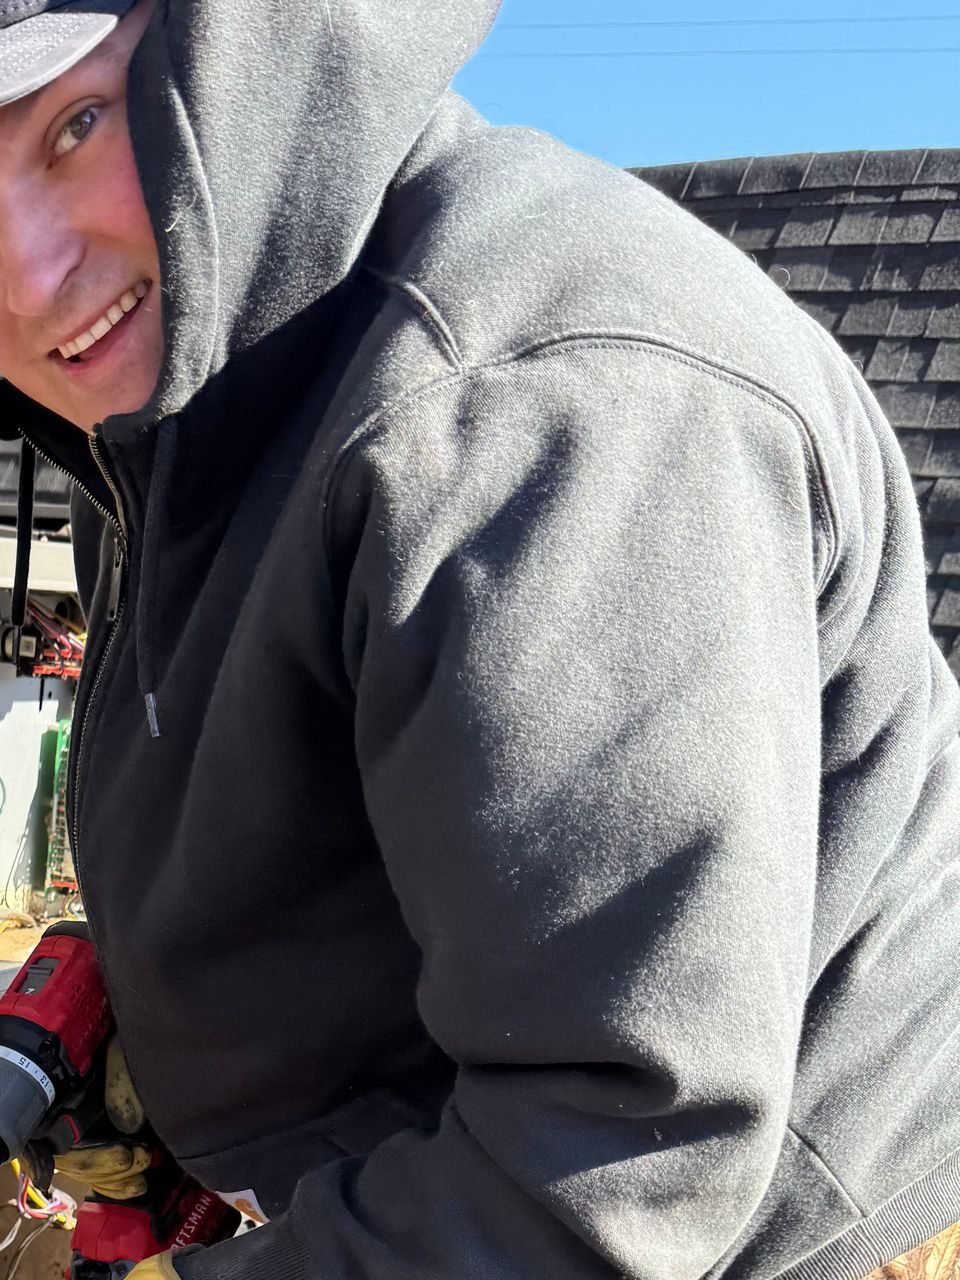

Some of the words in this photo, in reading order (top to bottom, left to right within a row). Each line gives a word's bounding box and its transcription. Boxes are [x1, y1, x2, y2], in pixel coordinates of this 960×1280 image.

[18, 1056, 31, 1069] 15
[40, 1075, 50, 1088] 13
[170, 1195, 212, 1250] AFTSMAN
